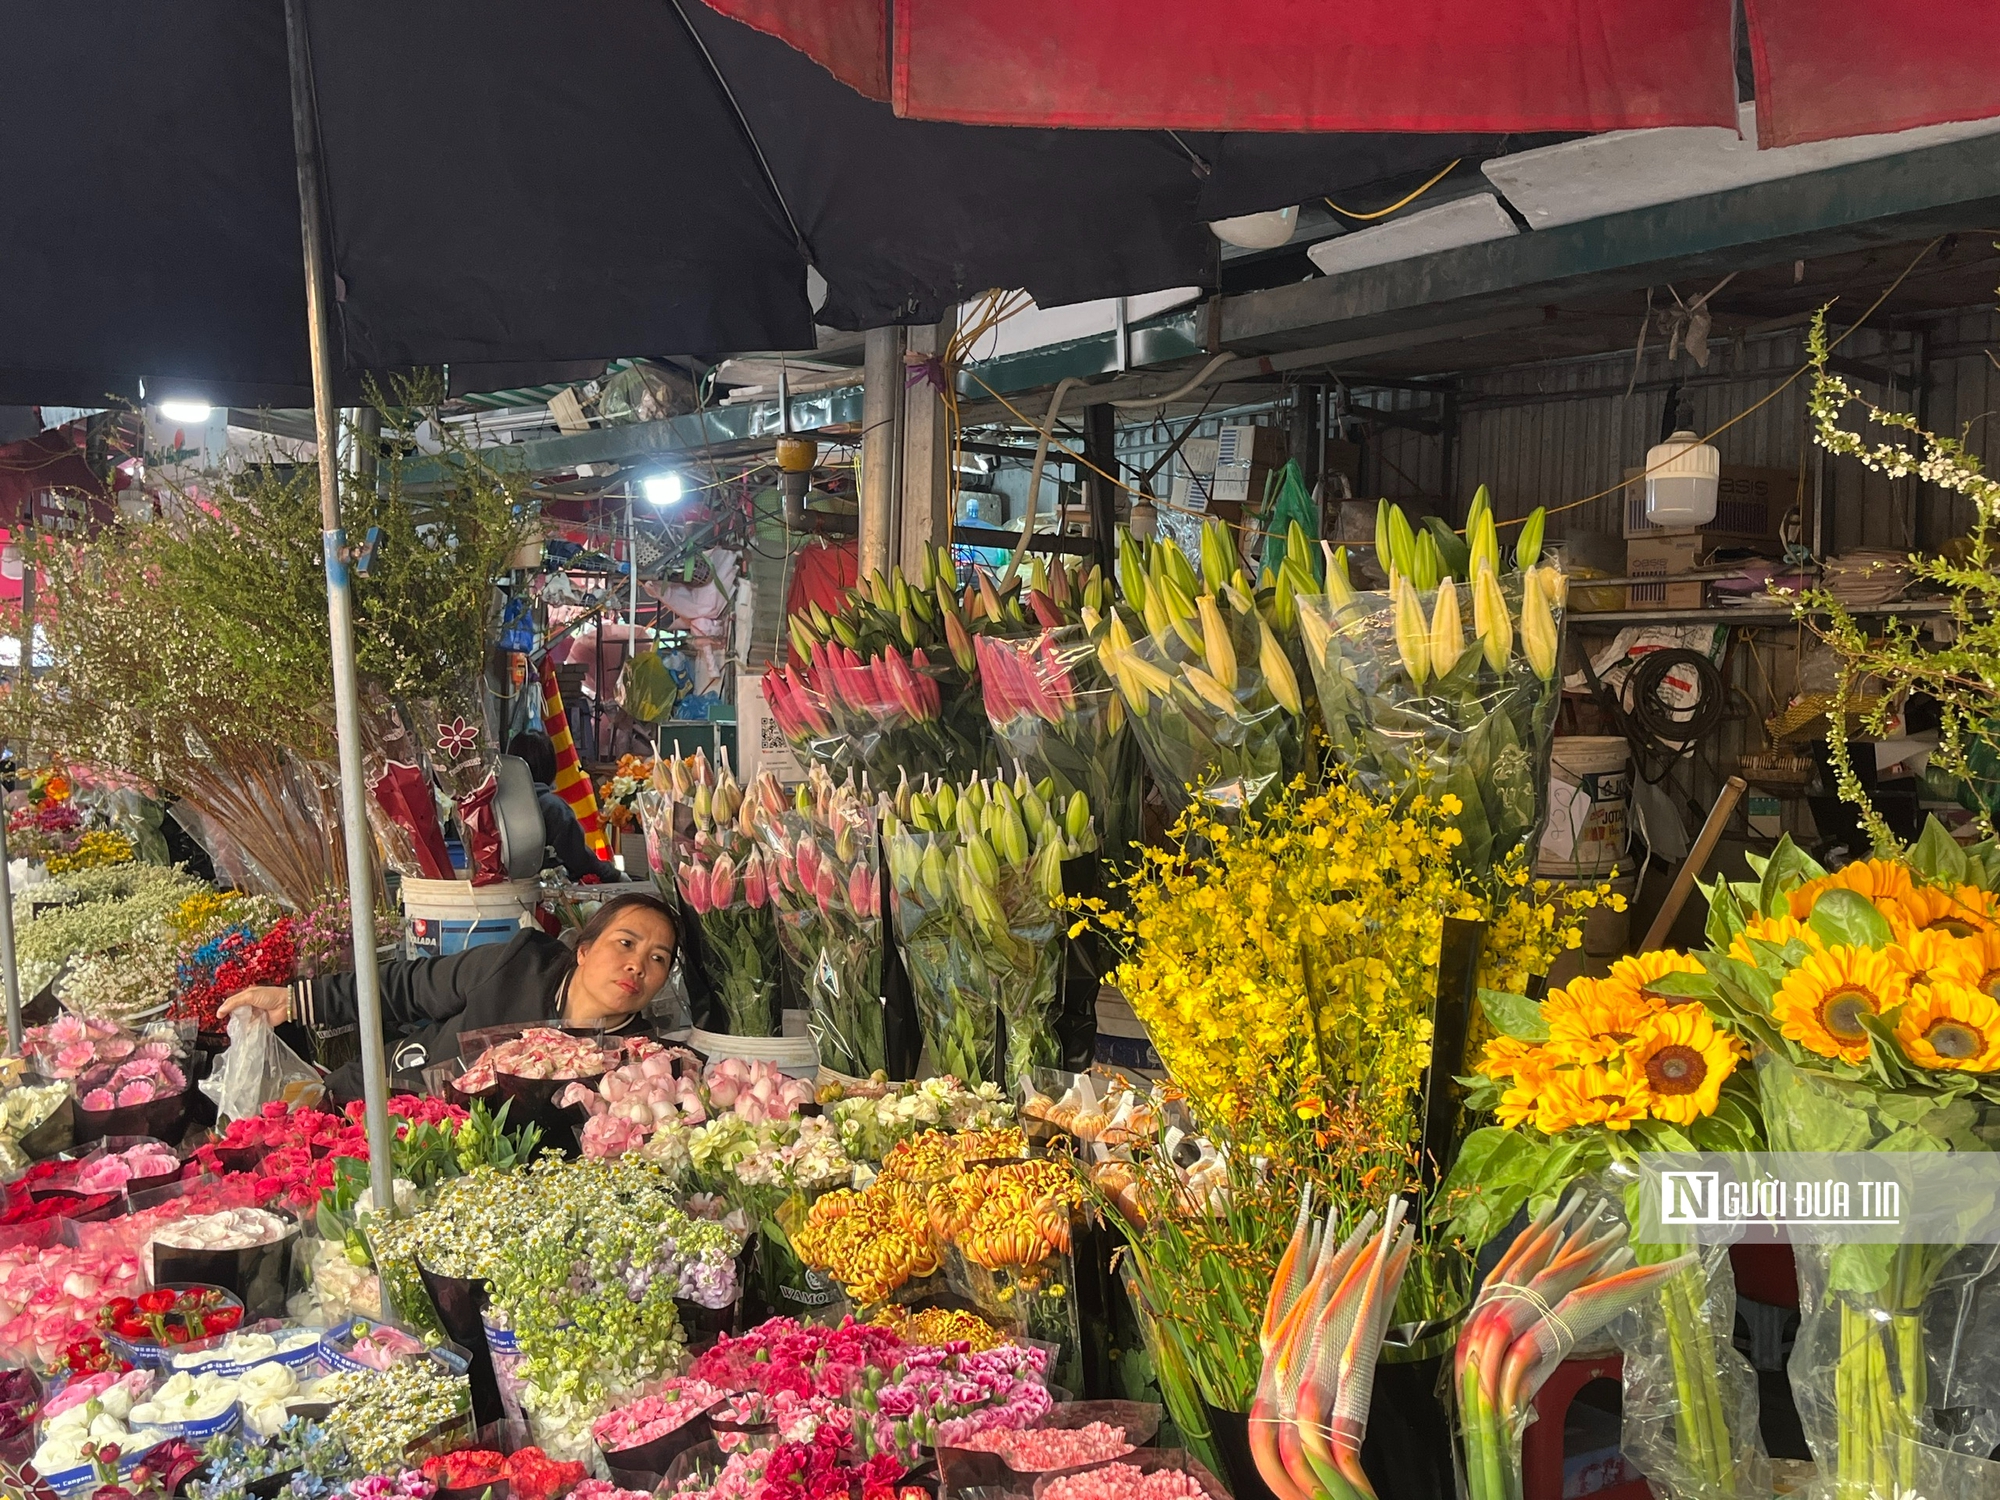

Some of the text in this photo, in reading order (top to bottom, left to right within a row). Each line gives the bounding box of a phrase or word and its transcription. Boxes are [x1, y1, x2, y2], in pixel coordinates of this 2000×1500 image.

[285, 1352, 315, 1366] Company
[210, 1411, 237, 1433] Company
[62, 1474, 92, 1487] Company
